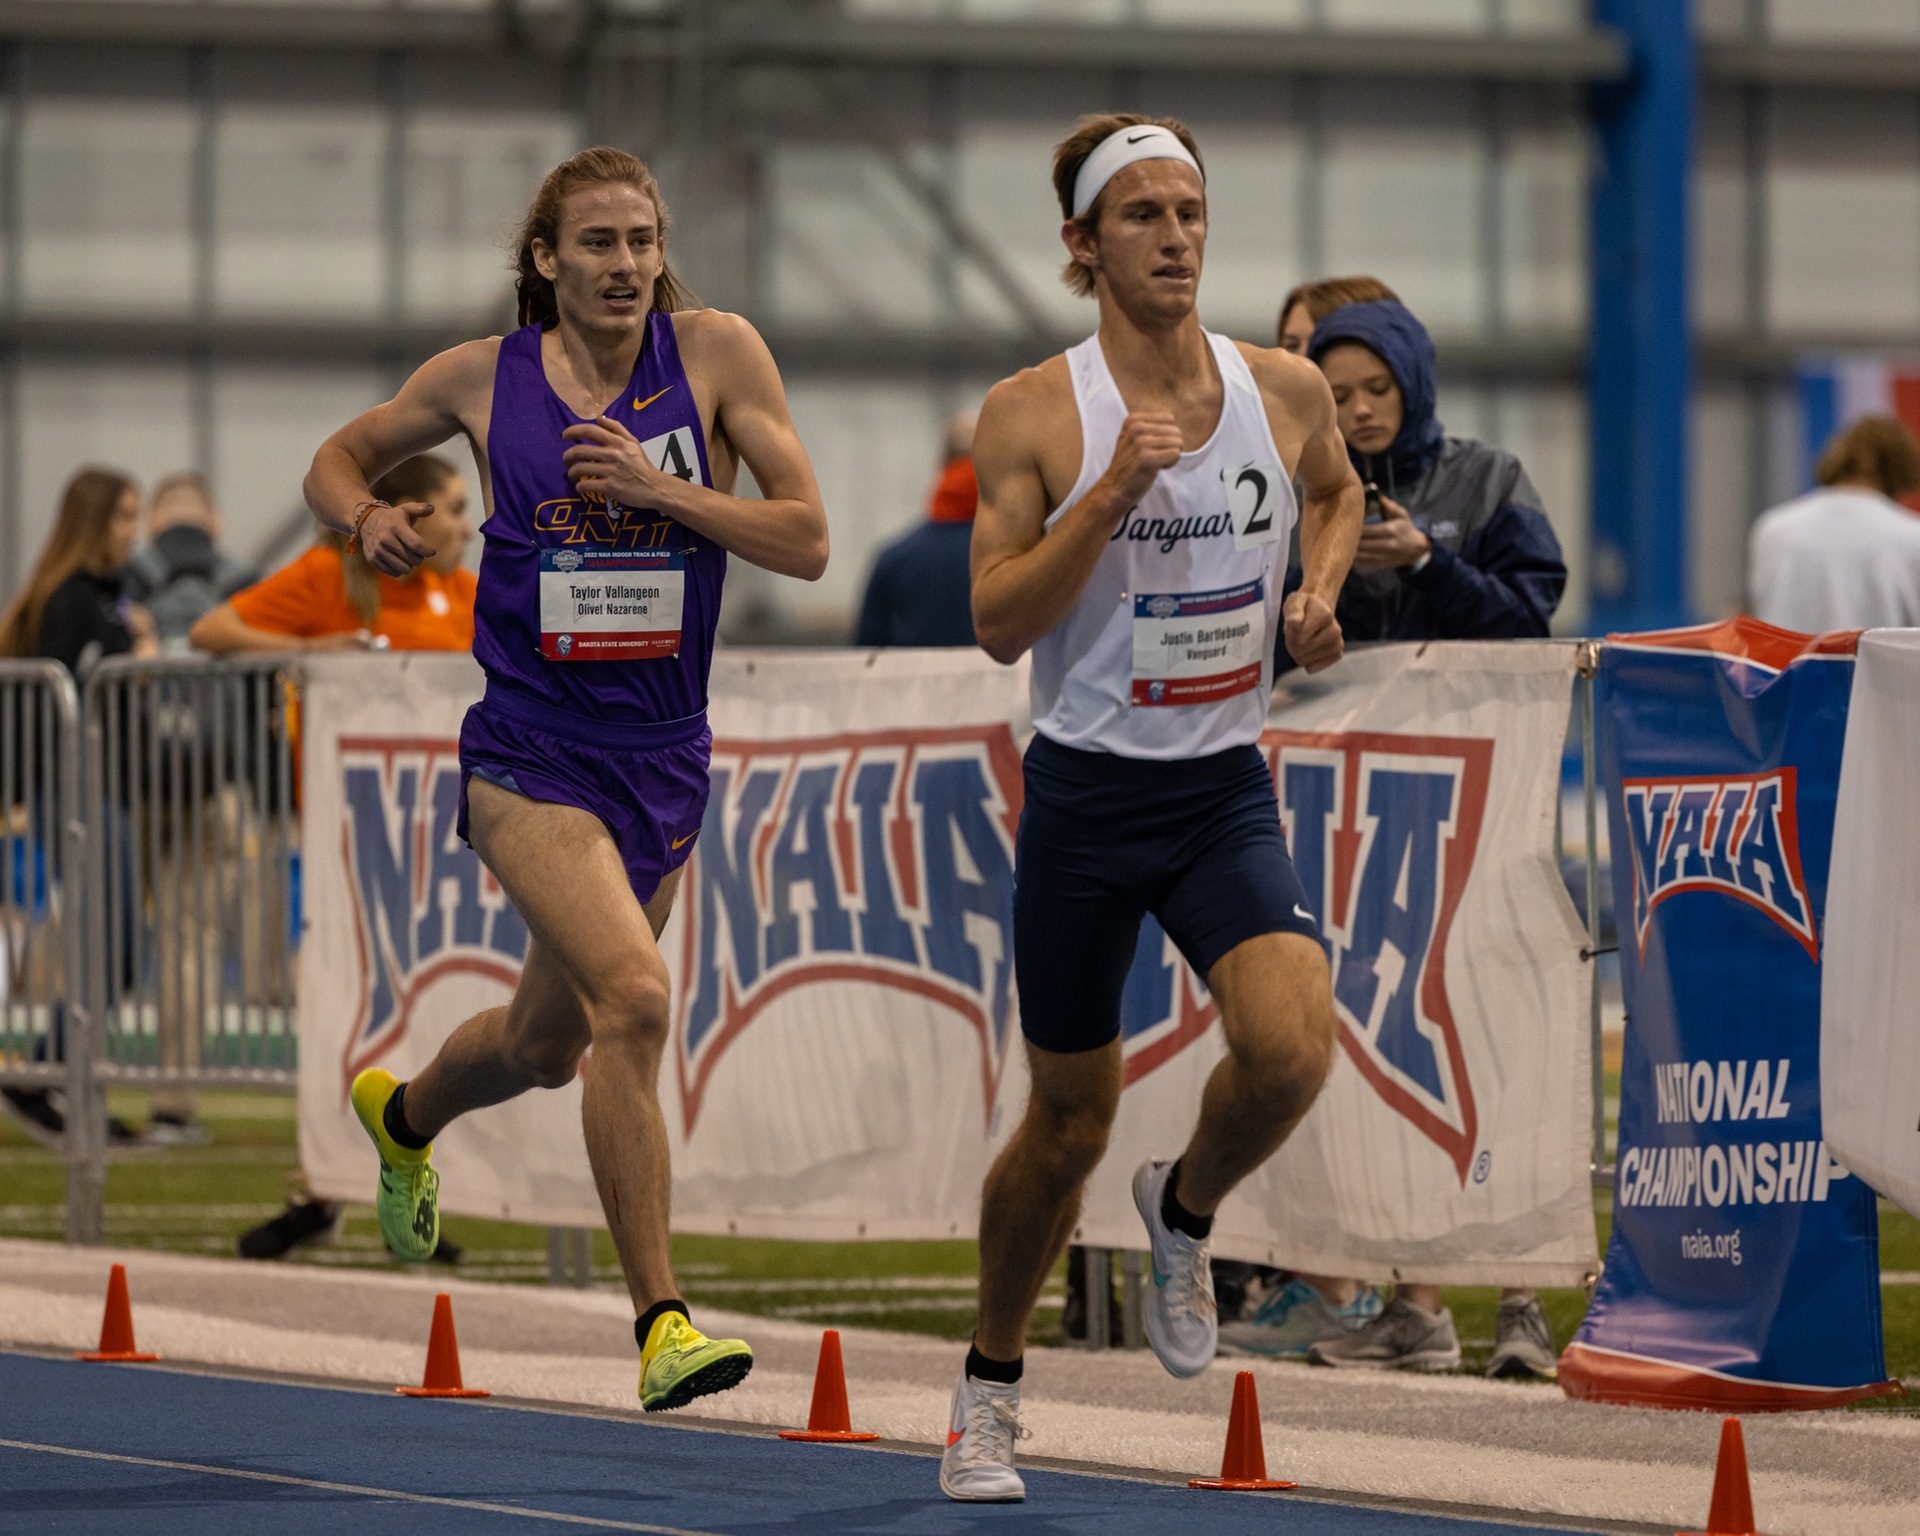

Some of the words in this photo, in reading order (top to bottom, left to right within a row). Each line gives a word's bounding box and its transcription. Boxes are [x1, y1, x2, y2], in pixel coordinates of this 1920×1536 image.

[1235, 467, 1274, 536] 2
[570, 586, 602, 600] Taylor
[605, 586, 660, 600] Vallangeon
[578, 603, 603, 615] Olivet
[607, 604, 648, 615] Nazarene
[1160, 632, 1193, 645] Justin
[1187, 645, 1227, 660] Vanguard
[1625, 784, 1808, 932] NAIA
[687, 757, 1016, 1052] NAIA
[1656, 1059, 1791, 1123] NATIONAL
[1681, 1229, 1742, 1266] naia.org
